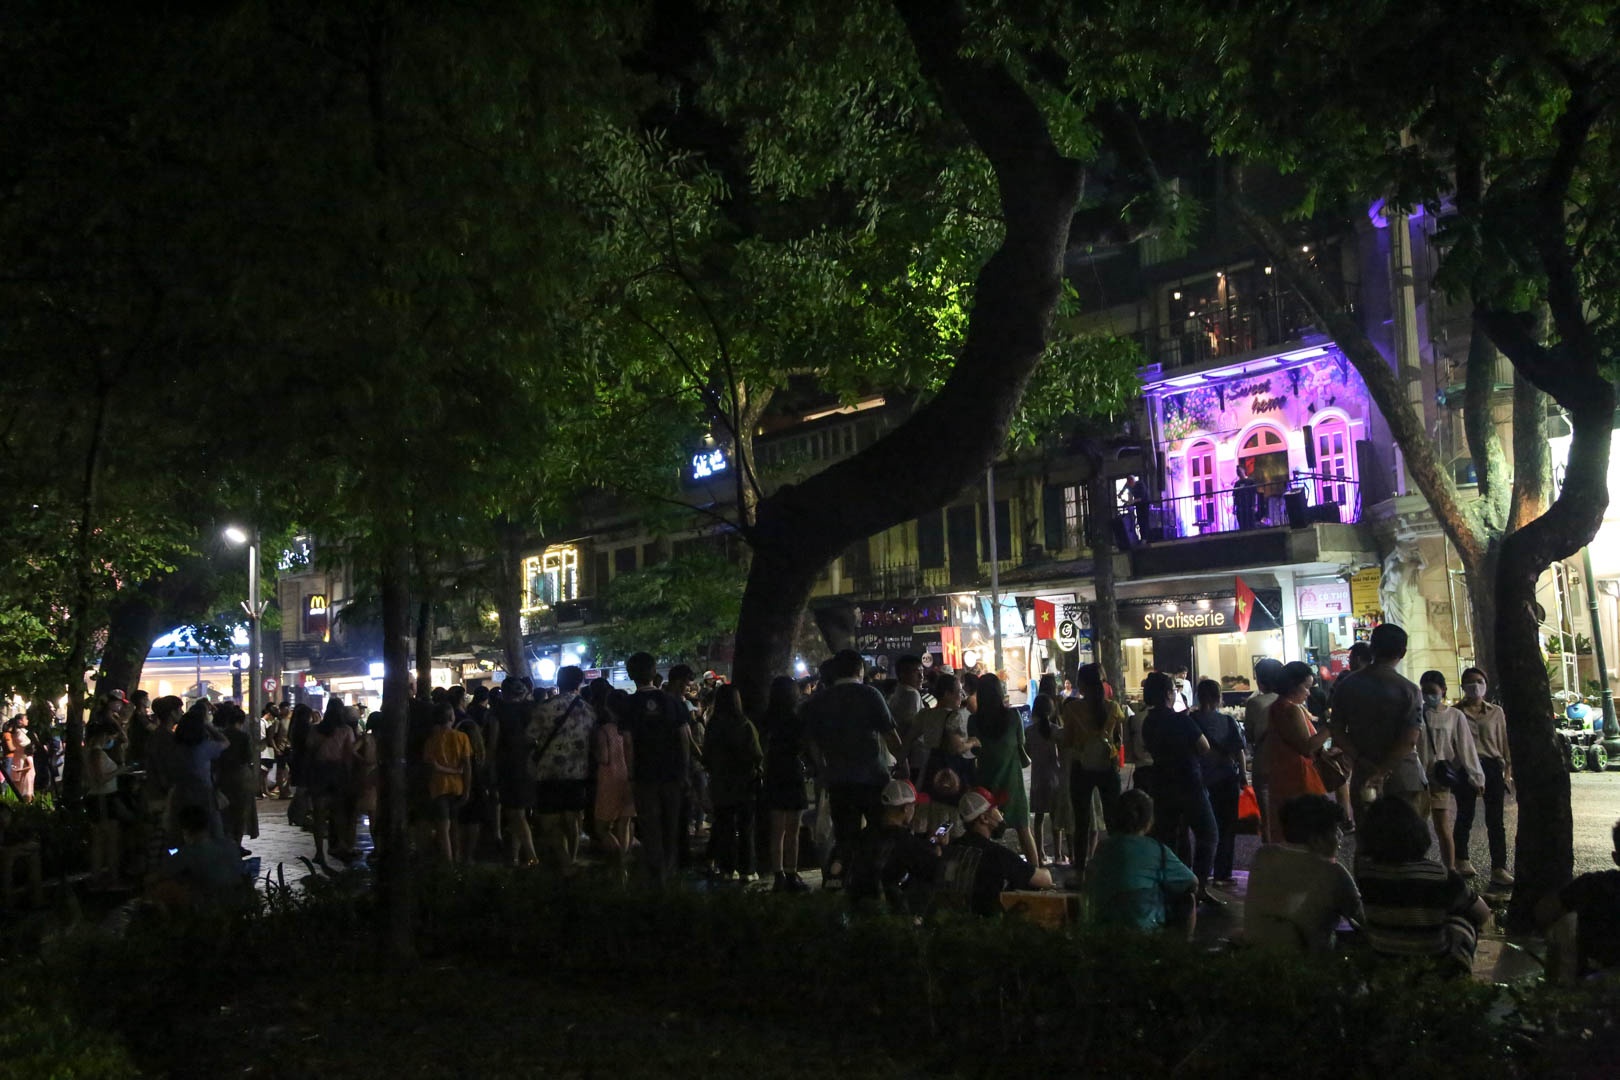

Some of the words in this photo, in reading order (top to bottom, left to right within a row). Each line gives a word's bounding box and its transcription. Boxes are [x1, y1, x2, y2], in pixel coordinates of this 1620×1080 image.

[1228, 379, 1271, 401] Sweet
[1251, 395, 1287, 414] home
[1144, 610, 1225, 630] S'Patisserie
